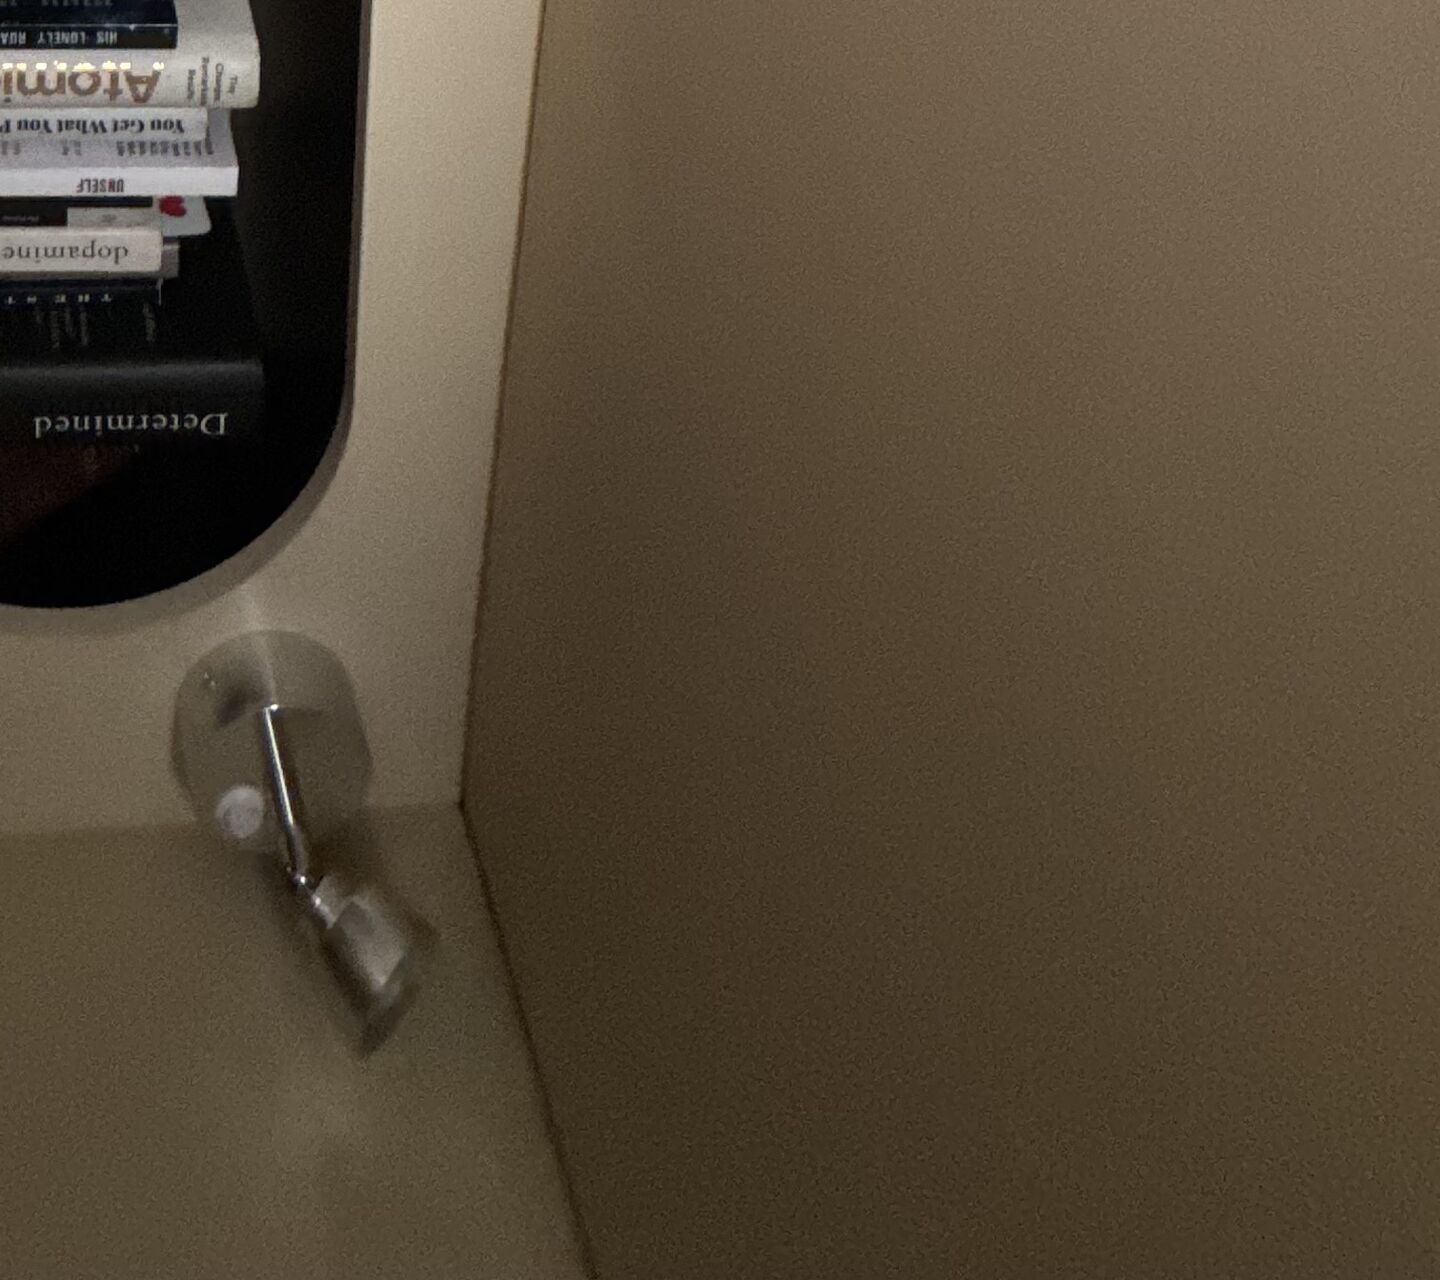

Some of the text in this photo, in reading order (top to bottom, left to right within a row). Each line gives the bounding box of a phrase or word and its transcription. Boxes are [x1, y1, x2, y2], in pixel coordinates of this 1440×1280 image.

[38, 31, 86, 44] LONELY
[96, 31, 118, 44] HIS
[17, 120, 53, 134] You
[57, 120, 107, 134] What
[112, 120, 146, 134] Get
[150, 120, 184, 134] You
[76, 179, 125, 194] UNSELF
[2, 240, 128, 264] dopamine
[34, 412, 228, 439] Determined
